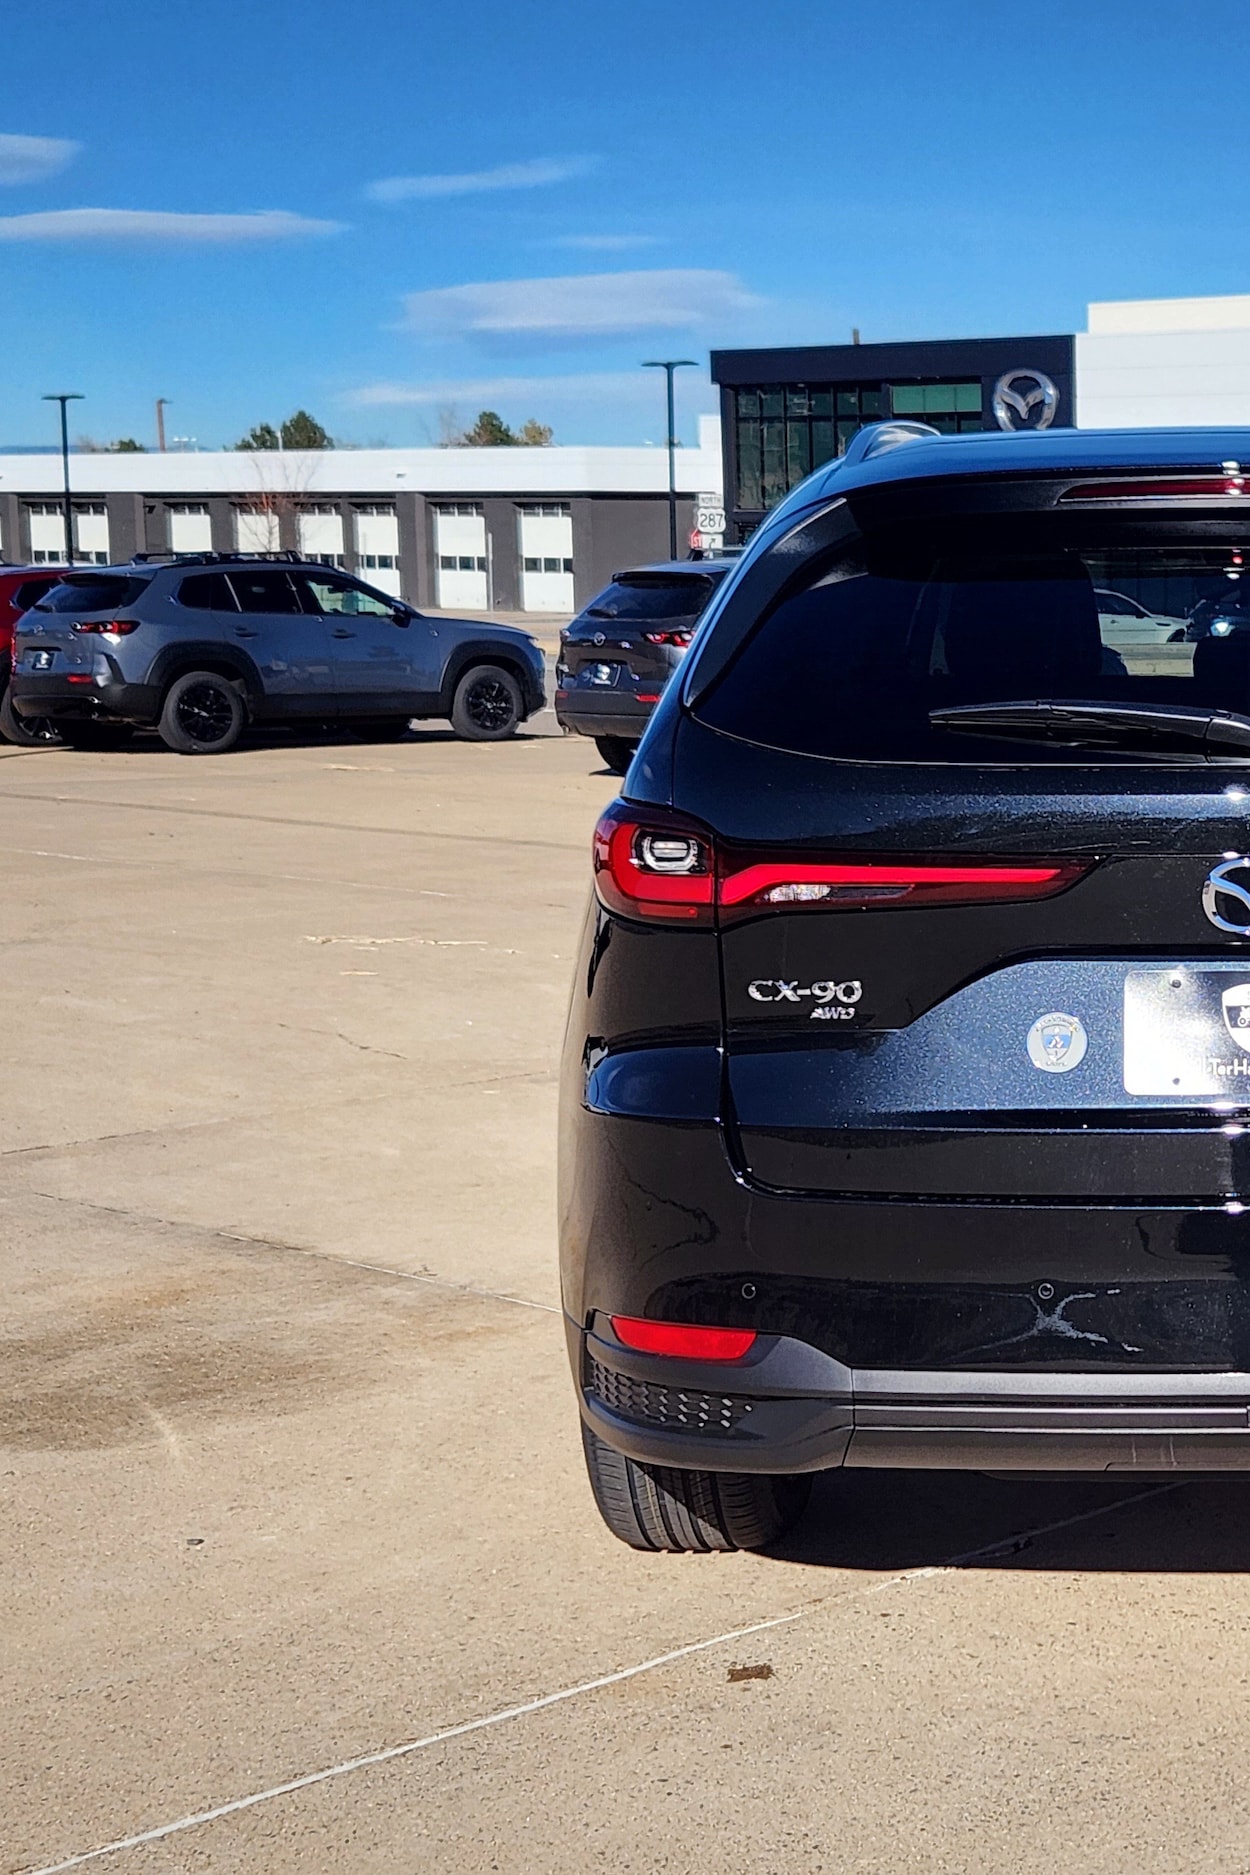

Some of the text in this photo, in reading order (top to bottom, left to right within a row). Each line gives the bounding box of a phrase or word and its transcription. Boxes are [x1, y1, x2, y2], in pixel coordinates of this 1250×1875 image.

[700, 513, 723, 528] 287
[748, 980, 863, 1004] CX-90
[810, 1006, 856, 1020] AWD
